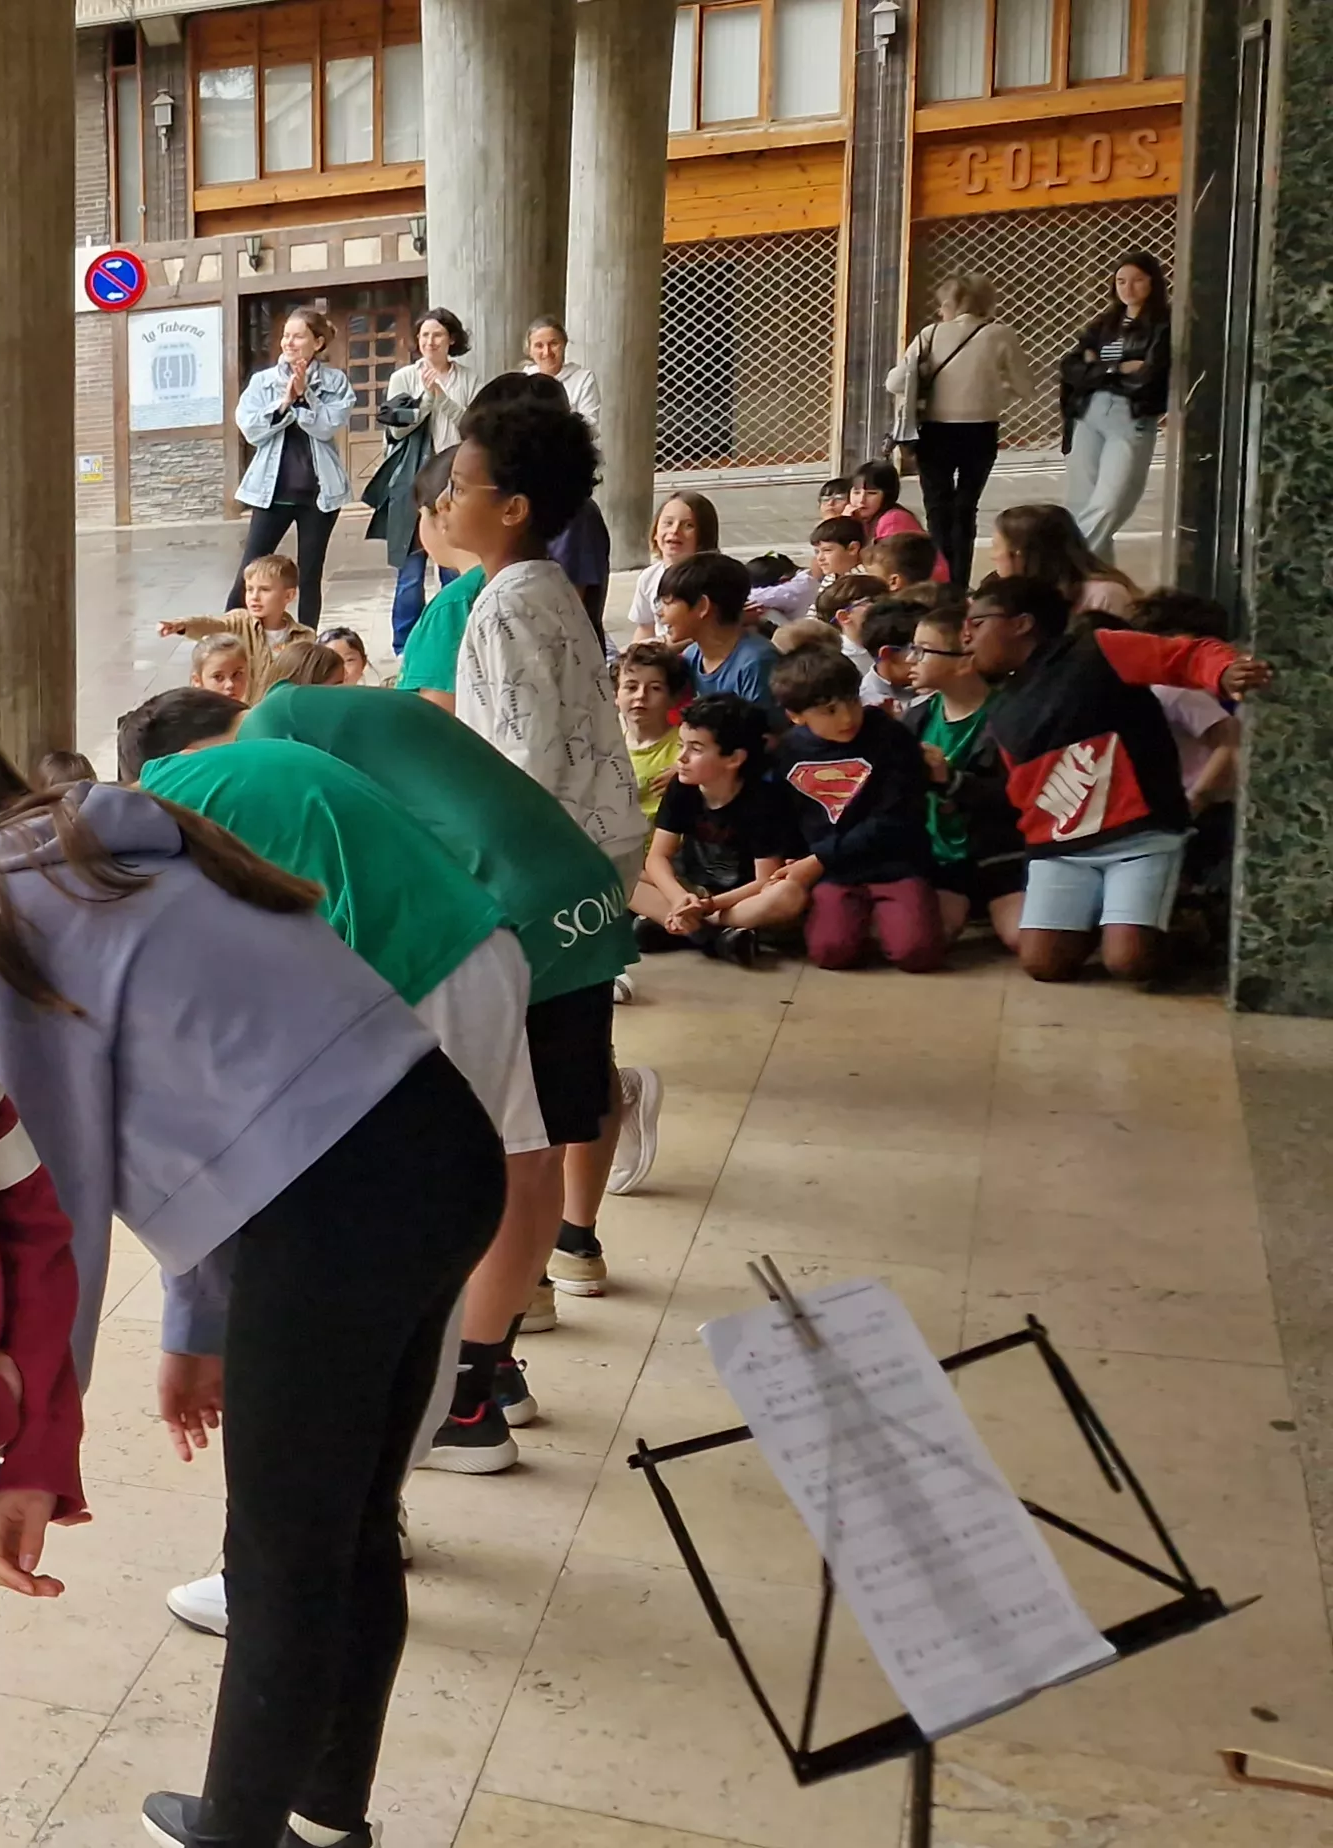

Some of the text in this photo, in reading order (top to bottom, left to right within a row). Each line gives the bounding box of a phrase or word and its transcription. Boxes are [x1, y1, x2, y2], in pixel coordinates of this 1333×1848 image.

[962, 128, 1159, 195] COLOS
[142, 321, 205, 343] La Taberna
[1035, 742, 1098, 830] NIKE
